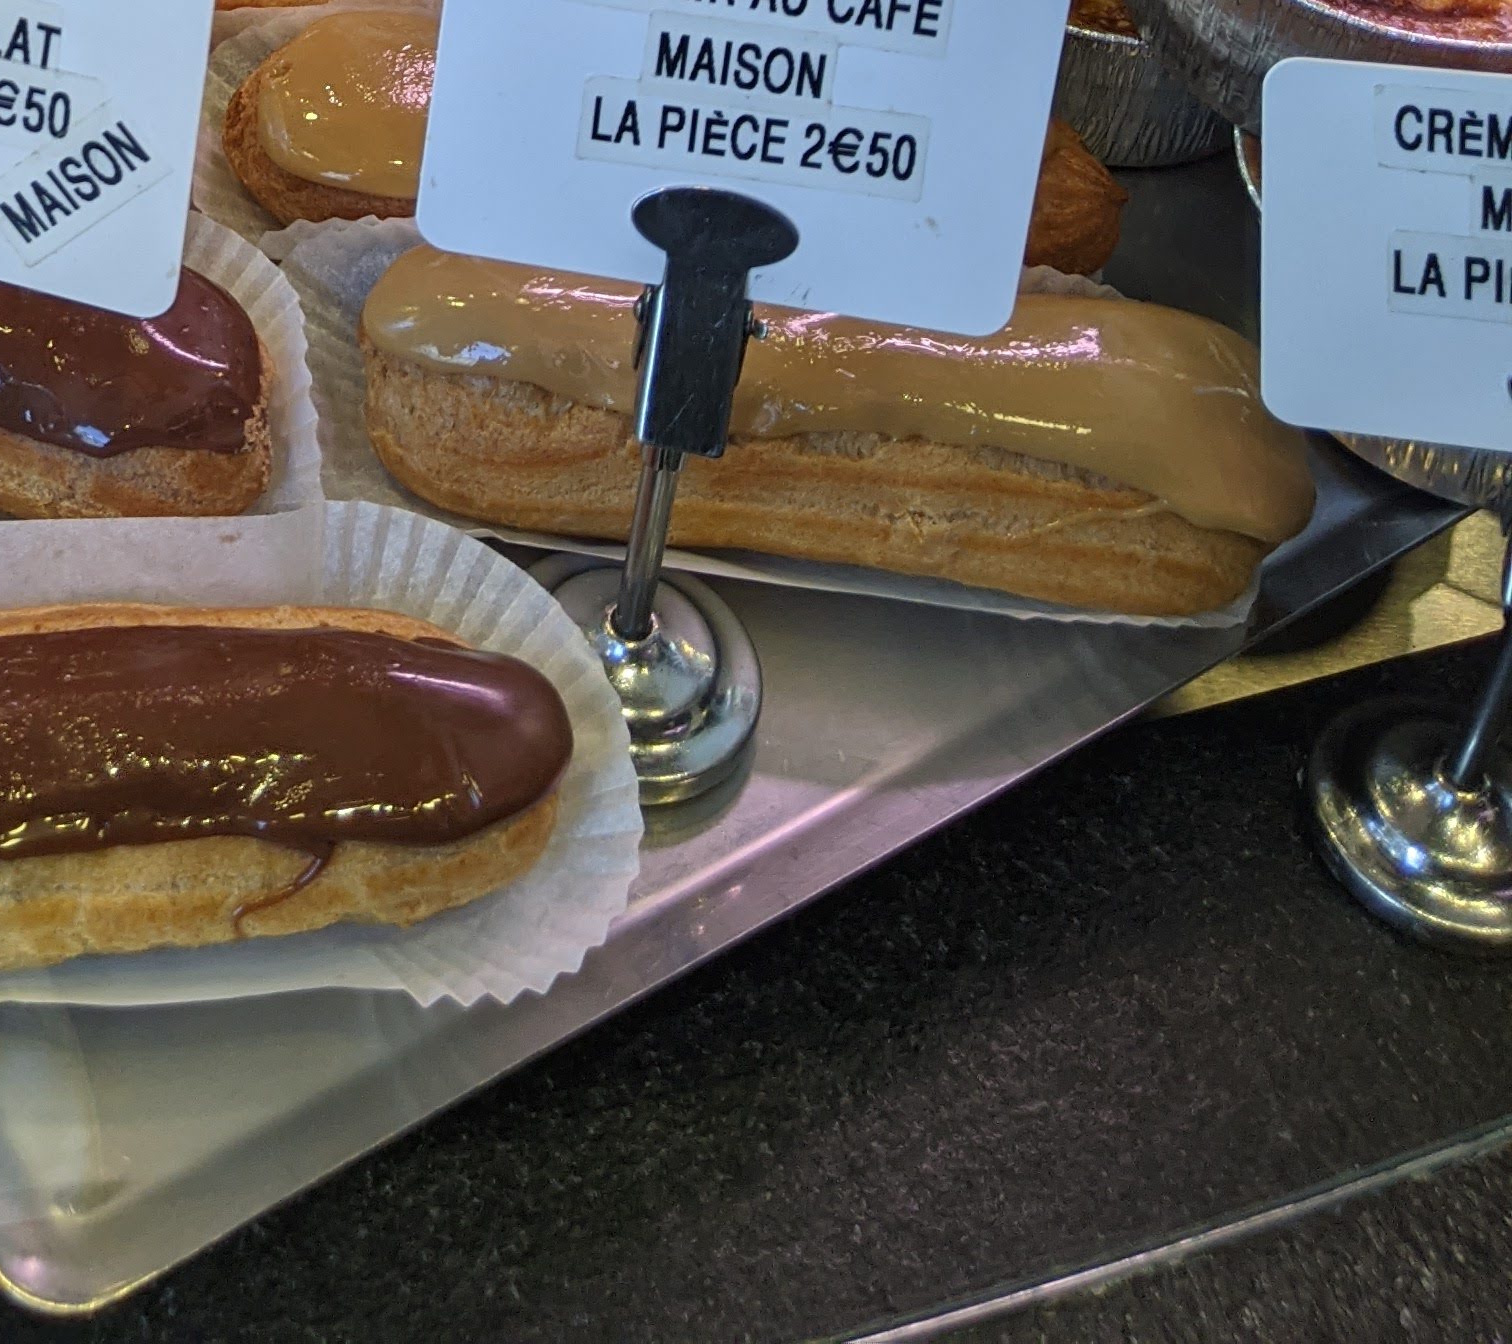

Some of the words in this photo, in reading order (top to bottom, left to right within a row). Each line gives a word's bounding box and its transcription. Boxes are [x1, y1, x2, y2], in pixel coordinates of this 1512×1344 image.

[655, 31, 828, 100] MAISON
[590, 96, 641, 146] LA
[657, 106, 790, 165] PIÈCE
[800, 122, 918, 182] 2€50
[1393, 249, 1447, 298] LA
[1464, 256, 1512, 305] PI
